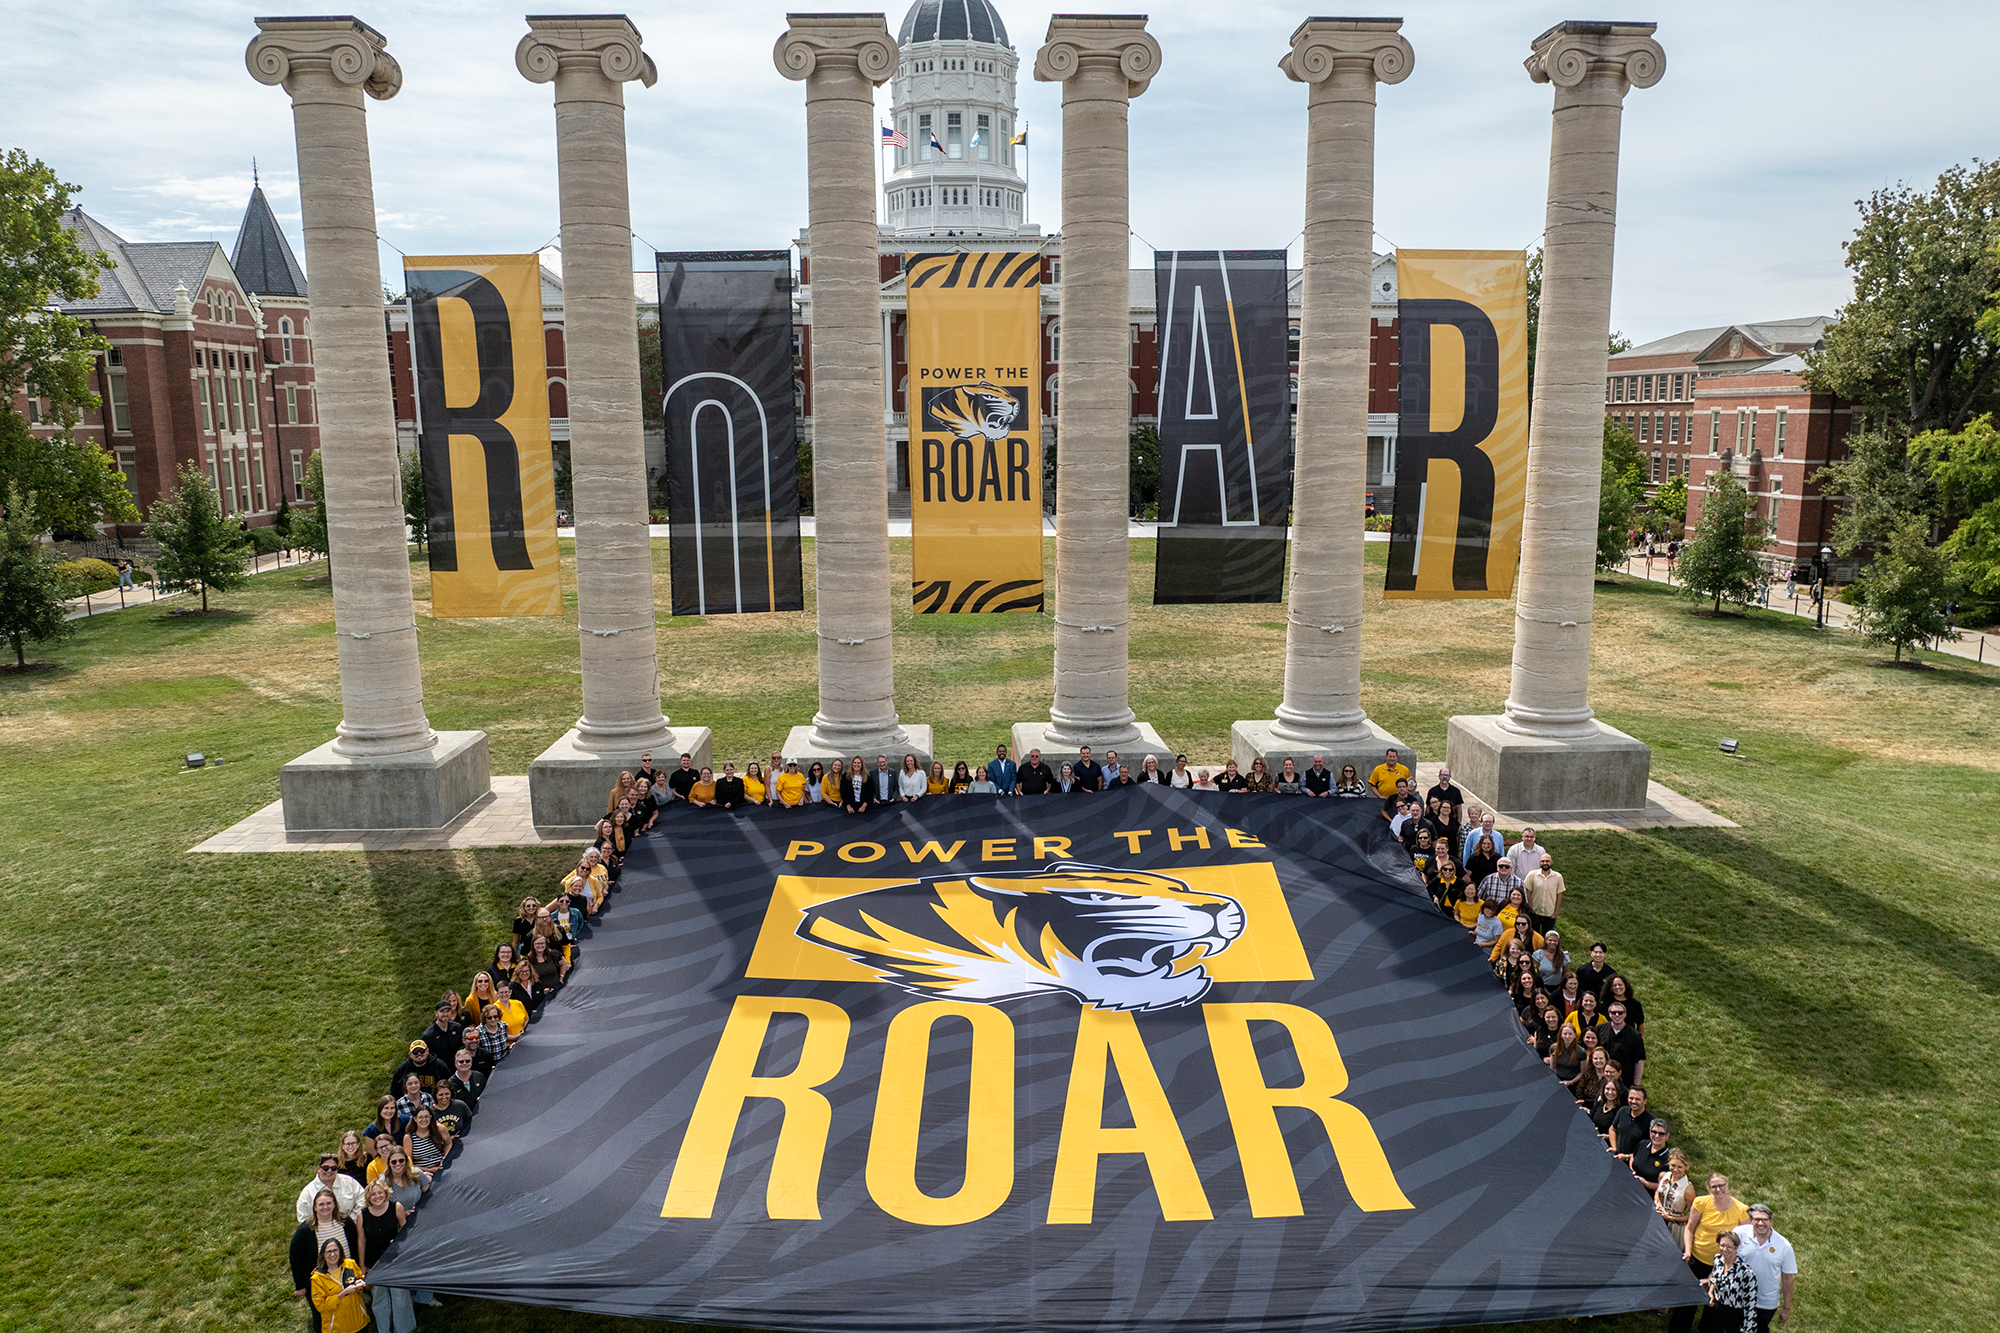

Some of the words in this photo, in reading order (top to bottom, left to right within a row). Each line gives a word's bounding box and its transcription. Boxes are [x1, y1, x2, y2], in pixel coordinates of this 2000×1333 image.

[405, 269, 535, 572] R
[920, 367, 986, 379] POWER
[994, 366, 1029, 379] THE
[922, 437, 1031, 503] ROAR
[1156, 250, 1260, 527] A
[1384, 298, 1500, 592] R
[783, 835, 1074, 864] POWER
[1113, 825, 1267, 855] THE
[660, 994, 1416, 1227] ROAR
